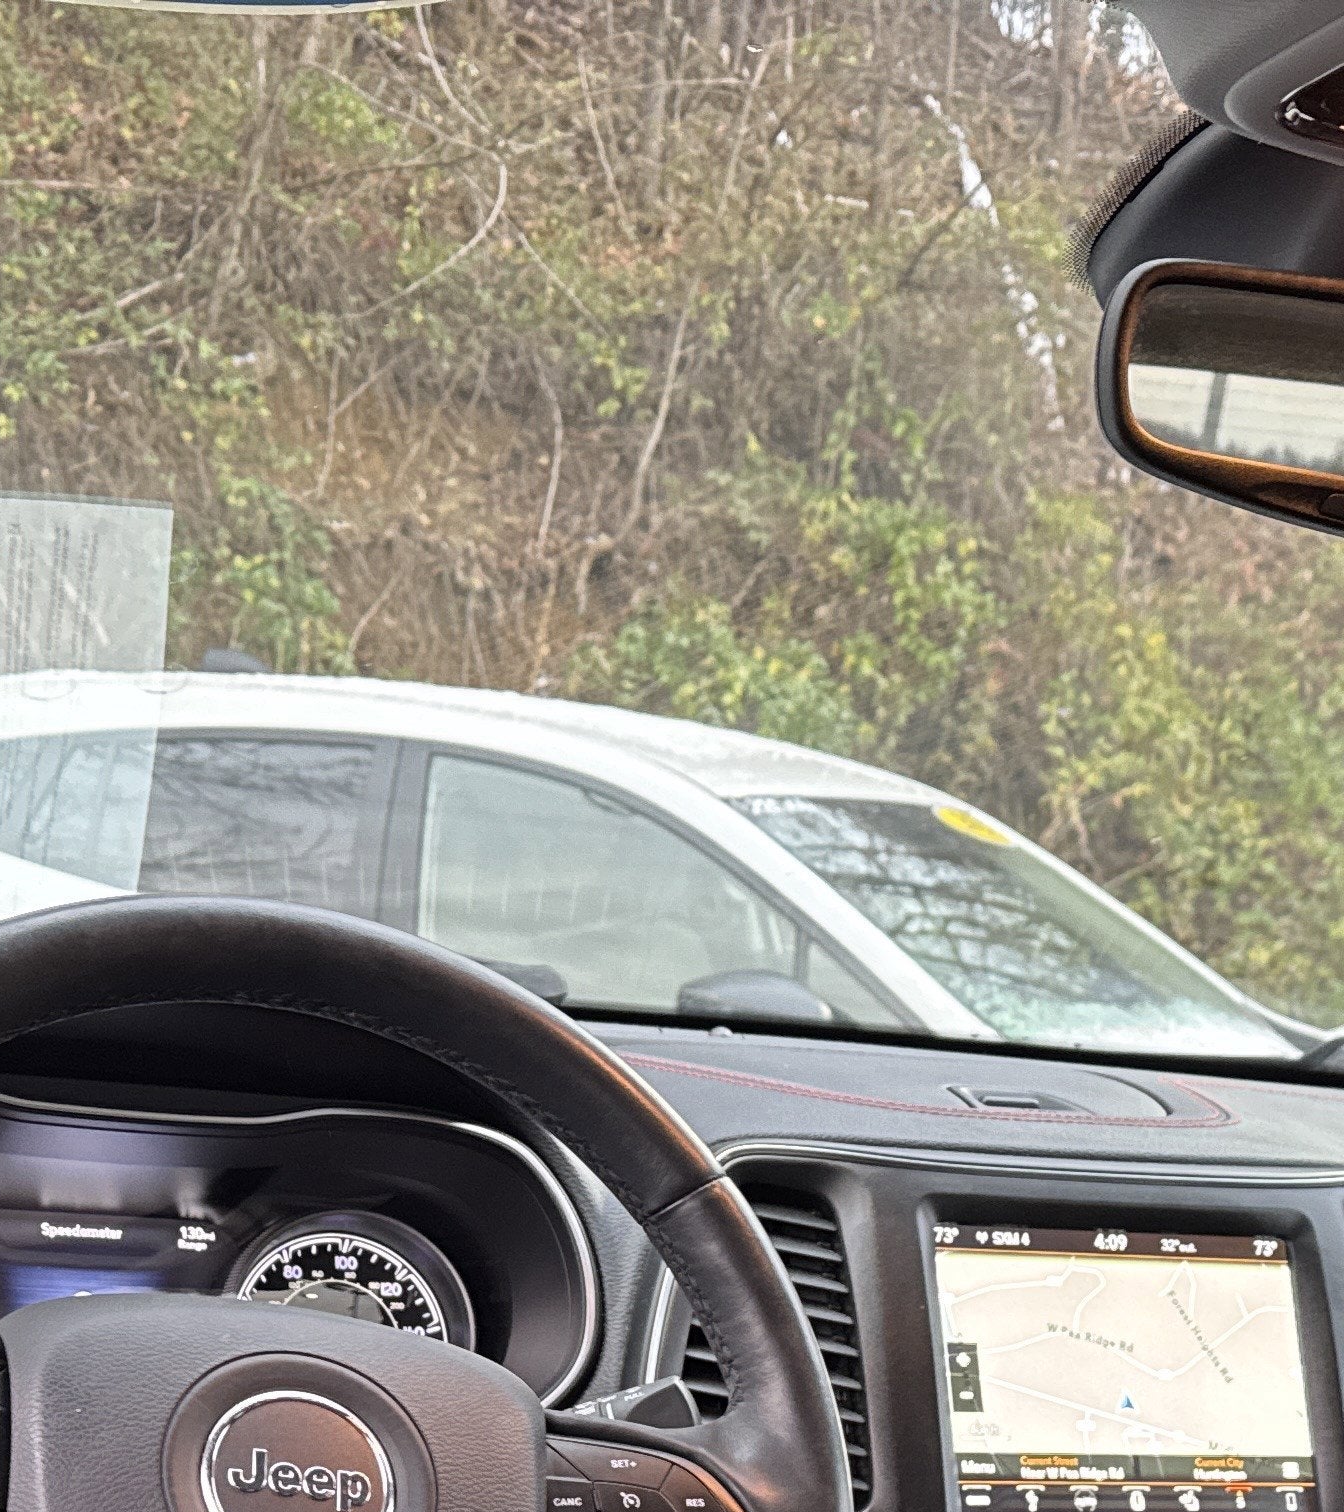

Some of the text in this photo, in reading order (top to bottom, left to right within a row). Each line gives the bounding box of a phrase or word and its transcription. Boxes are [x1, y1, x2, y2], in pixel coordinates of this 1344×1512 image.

[40, 1222, 123, 1240] Speedometer
[1093, 1233, 1128, 1251] 4:09
[334, 1255, 358, 1270] 100
[283, 1265, 303, 1279] 80
[380, 1282, 403, 1297] 120
[227, 1447, 372, 1512] Jeep
[552, 1497, 583, 1507] CANC
[685, 1498, 706, 1508] RES
